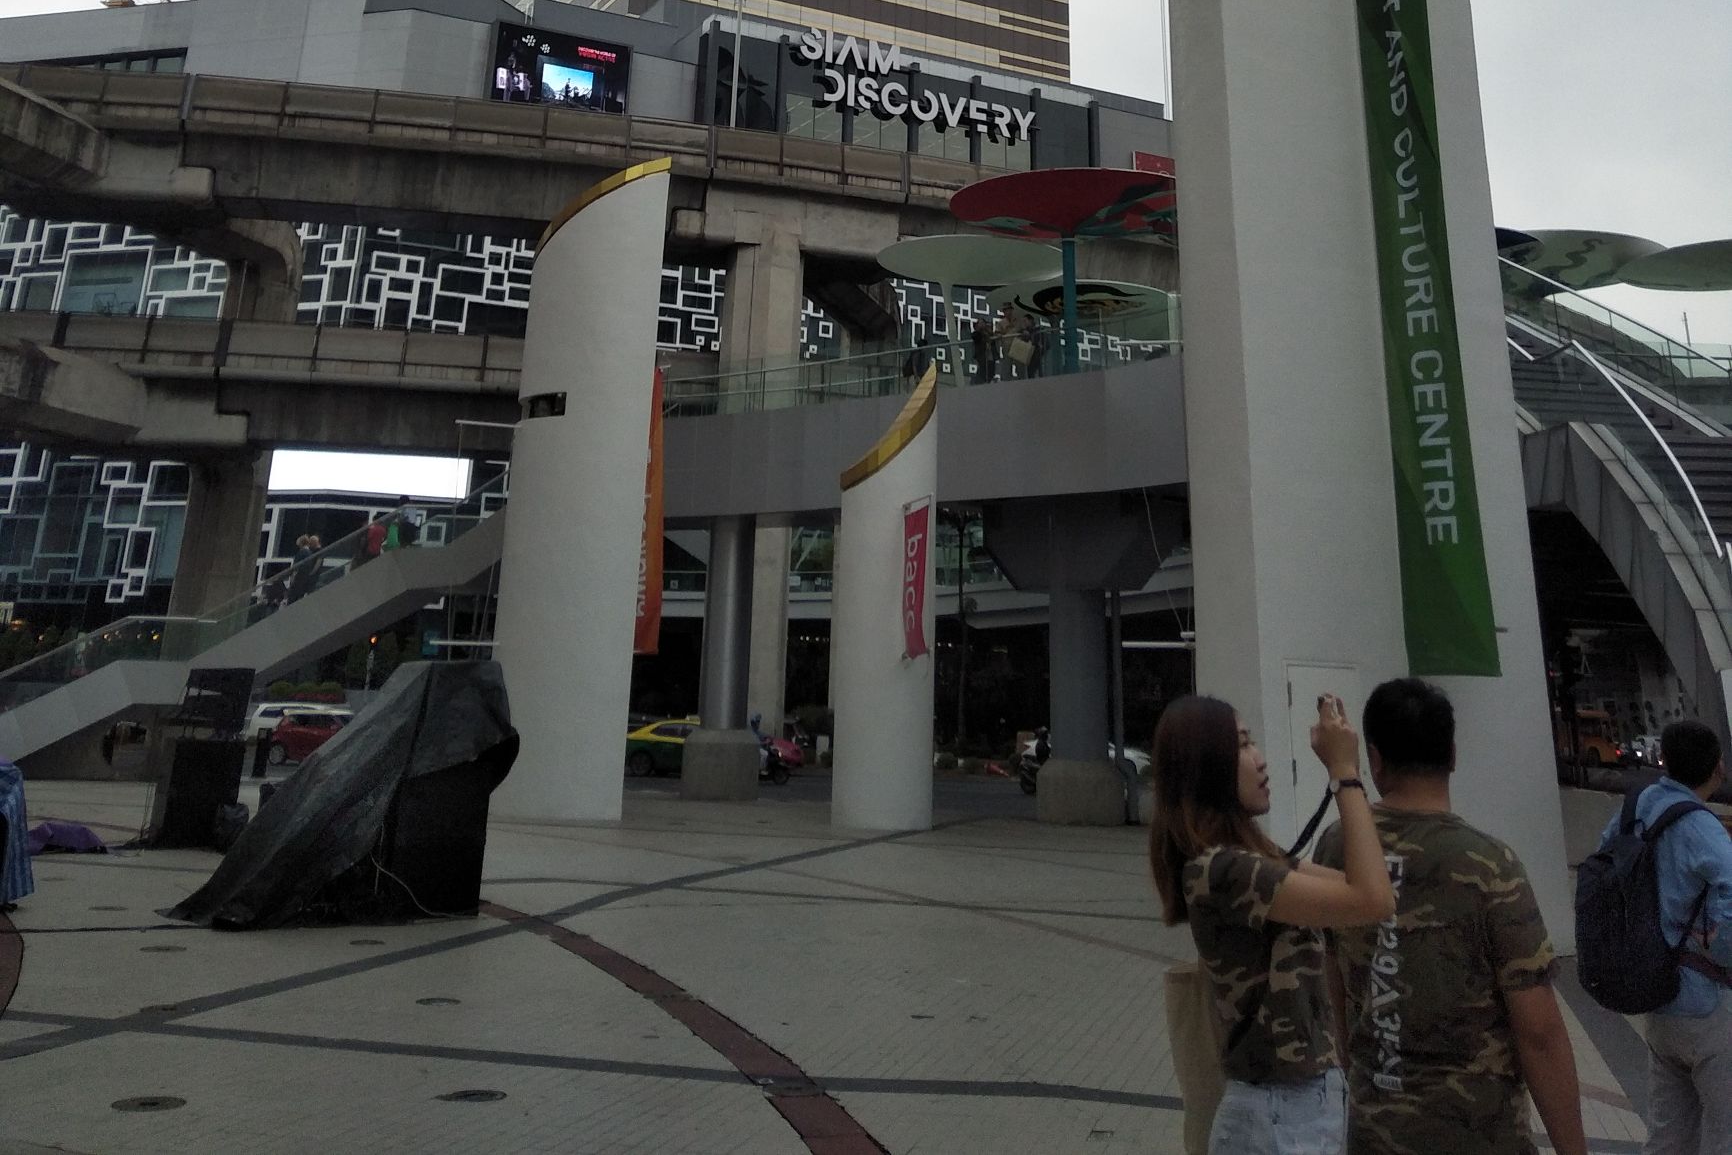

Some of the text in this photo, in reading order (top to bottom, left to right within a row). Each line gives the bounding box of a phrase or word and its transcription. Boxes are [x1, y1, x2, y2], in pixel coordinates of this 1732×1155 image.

[800, 27, 900, 75] SIAM
[1384, 30, 1408, 117] AND
[823, 68, 1036, 141] DISCOVERY
[1394, 126, 1440, 337] CULTURE
[1410, 349, 1459, 545] CENTRE
[905, 533, 923, 632] bacc
